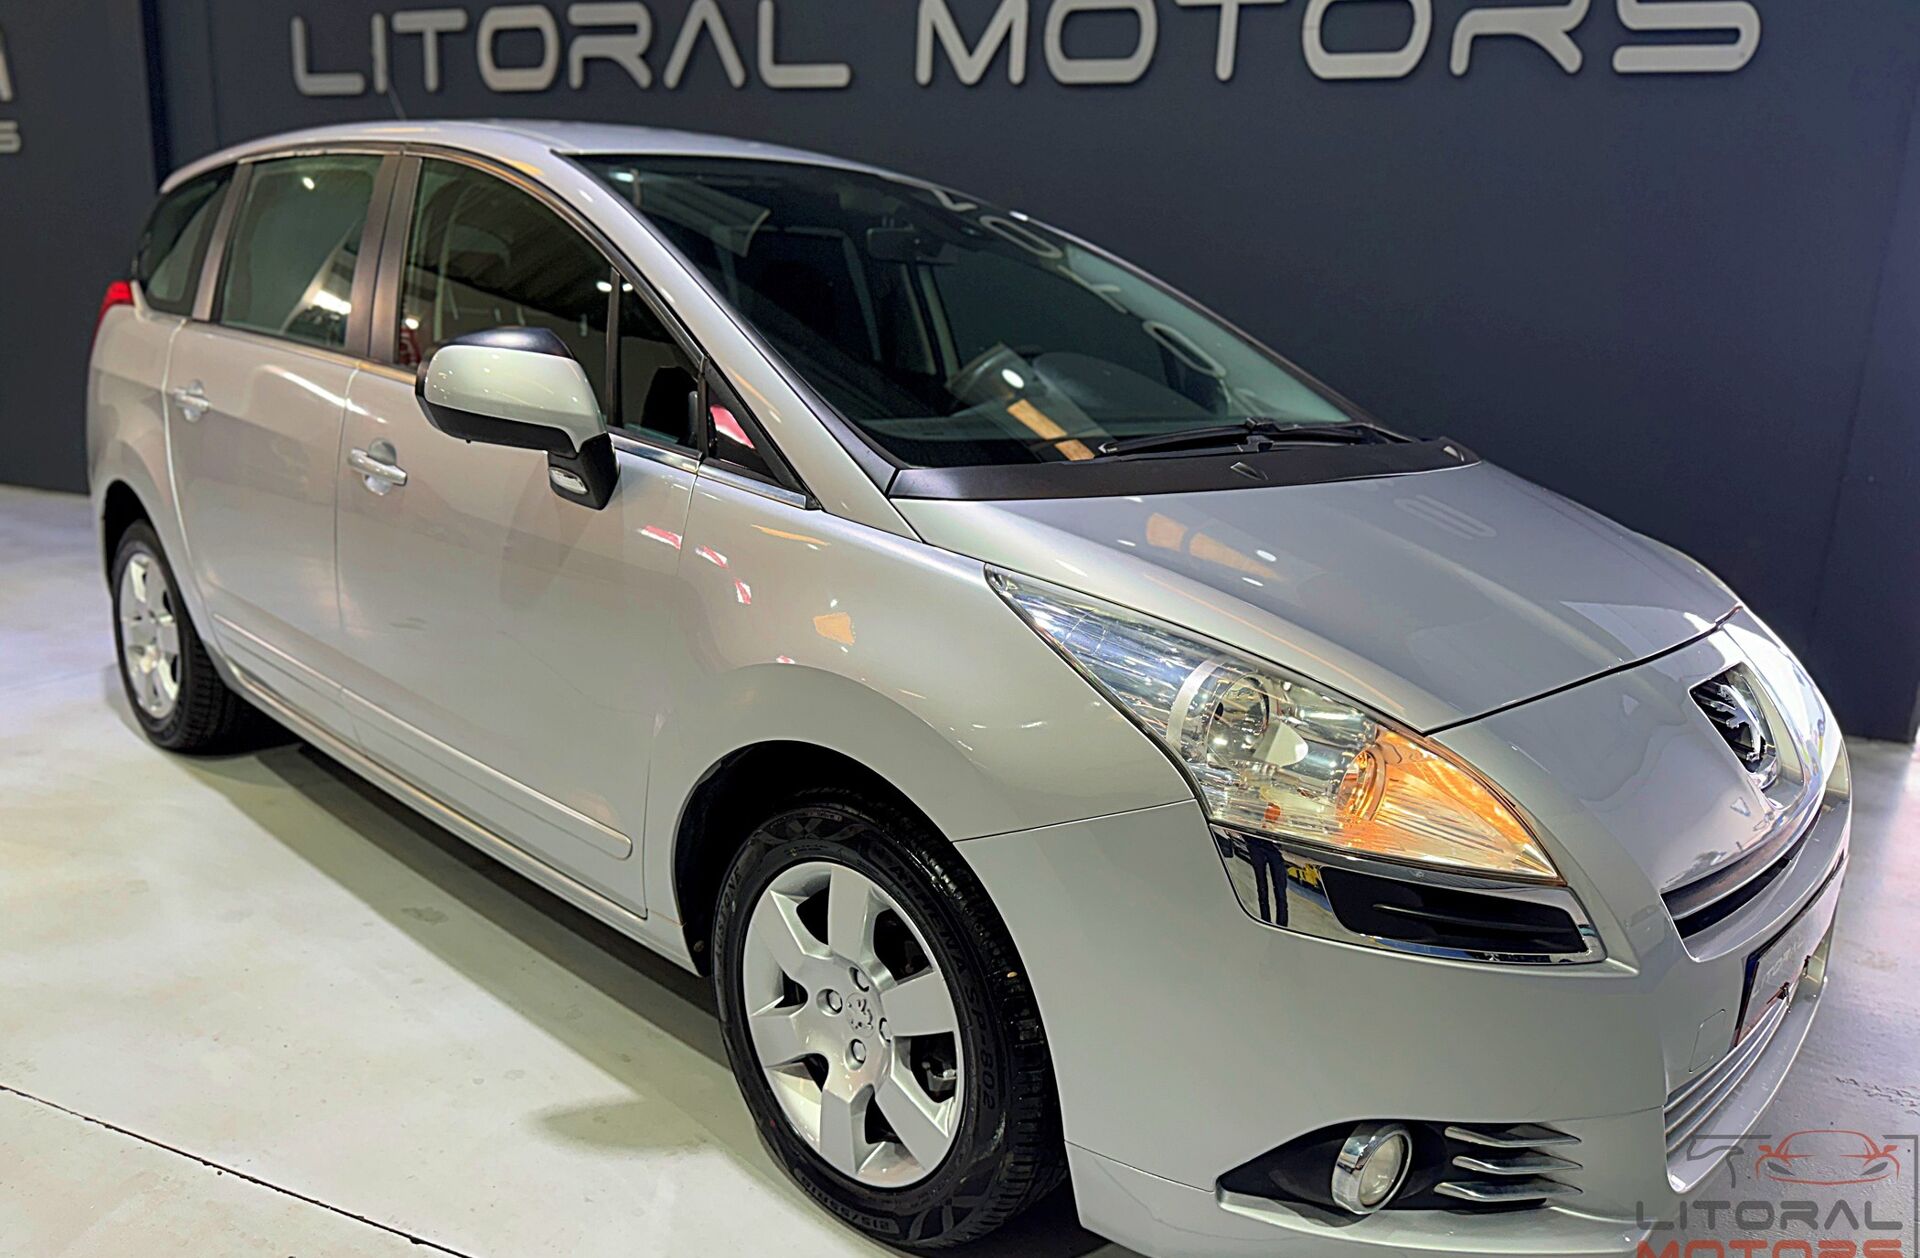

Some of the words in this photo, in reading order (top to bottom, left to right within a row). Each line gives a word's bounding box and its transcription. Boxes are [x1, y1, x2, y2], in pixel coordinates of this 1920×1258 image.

[291, 0, 851, 95] LITORAL
[915, 0, 1761, 85] MOTORS
[714, 864, 742, 967] AUSTONE
[965, 987, 996, 1110] SP-802
